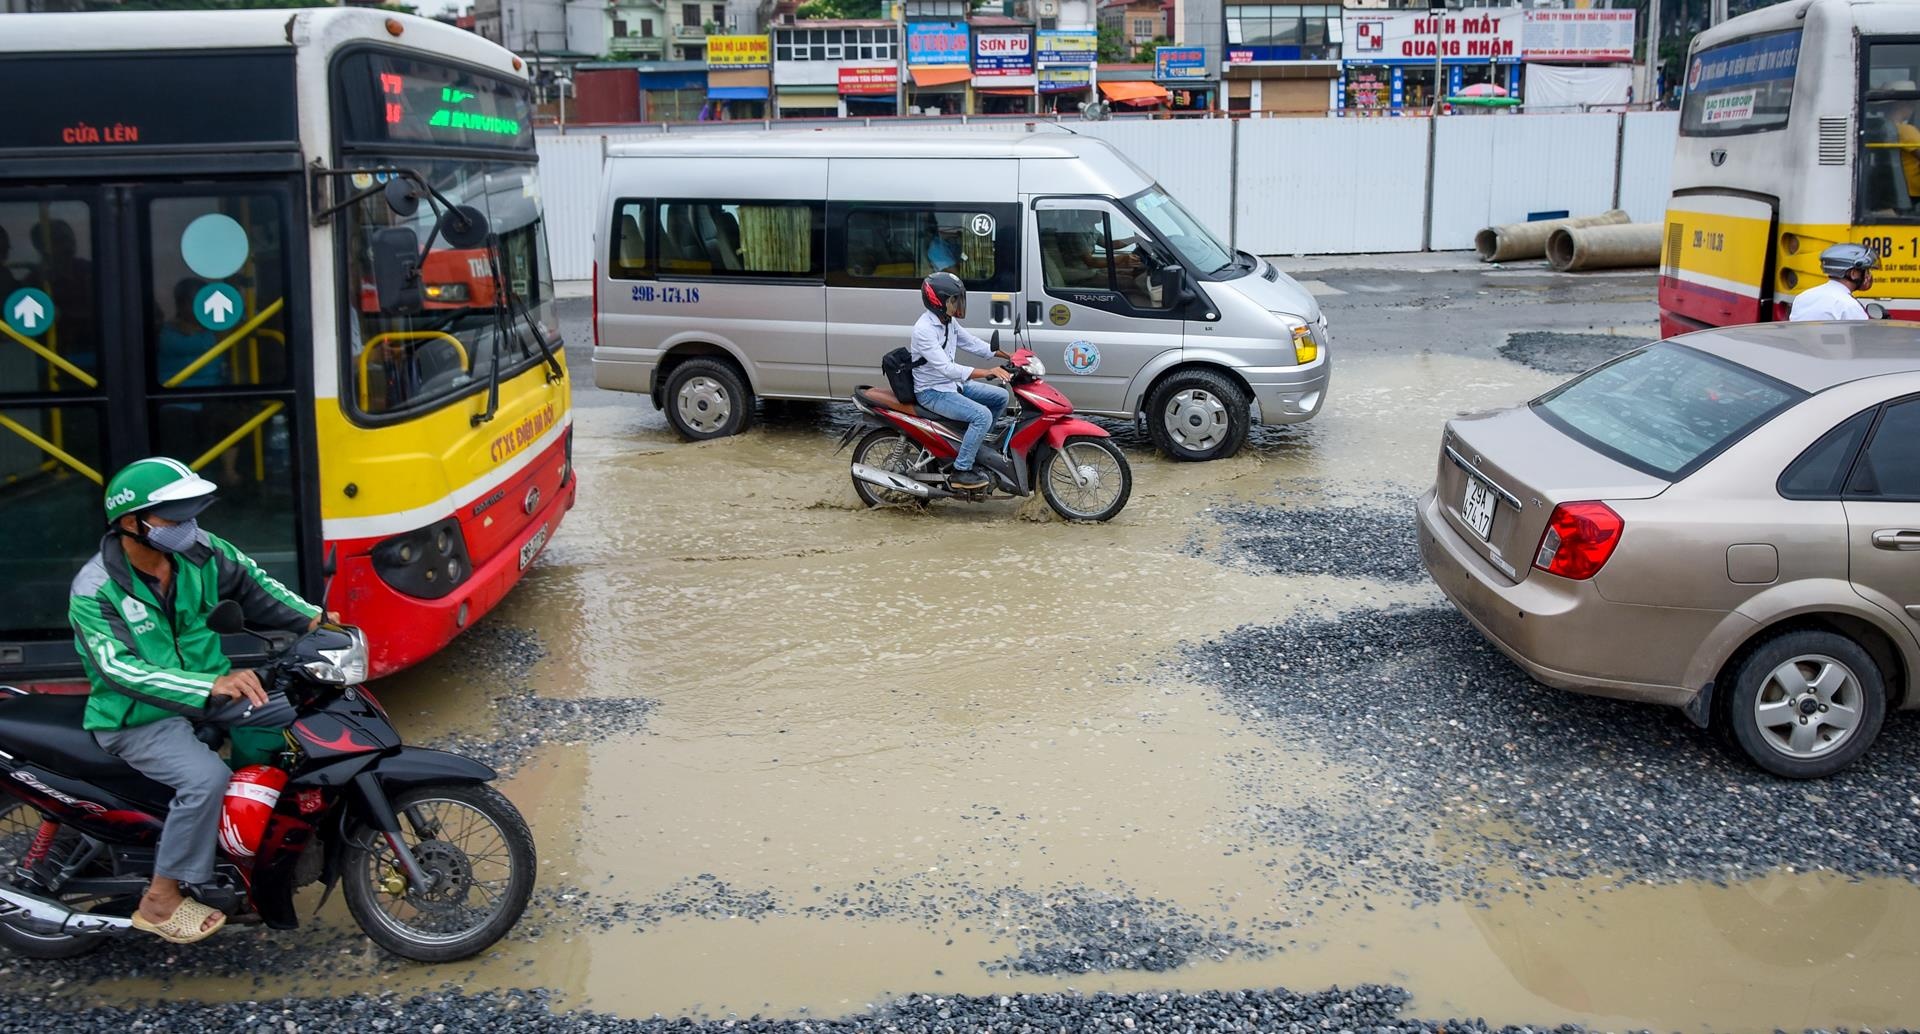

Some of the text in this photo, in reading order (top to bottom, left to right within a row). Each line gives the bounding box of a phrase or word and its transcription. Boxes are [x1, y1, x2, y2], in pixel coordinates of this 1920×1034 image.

[1462, 12, 1500, 34] MẮT
[980, 38, 1027, 50] SƠN PU
[1402, 40, 1460, 56] QUANG
[1732, 95, 1752, 107] GROUP
[63, 121, 138, 143] CỬA LÊN
[976, 218, 989, 231] F4
[106, 488, 136, 510] Grab
[1472, 481, 1487, 509] 29A
[134, 620, 155, 636] rab
